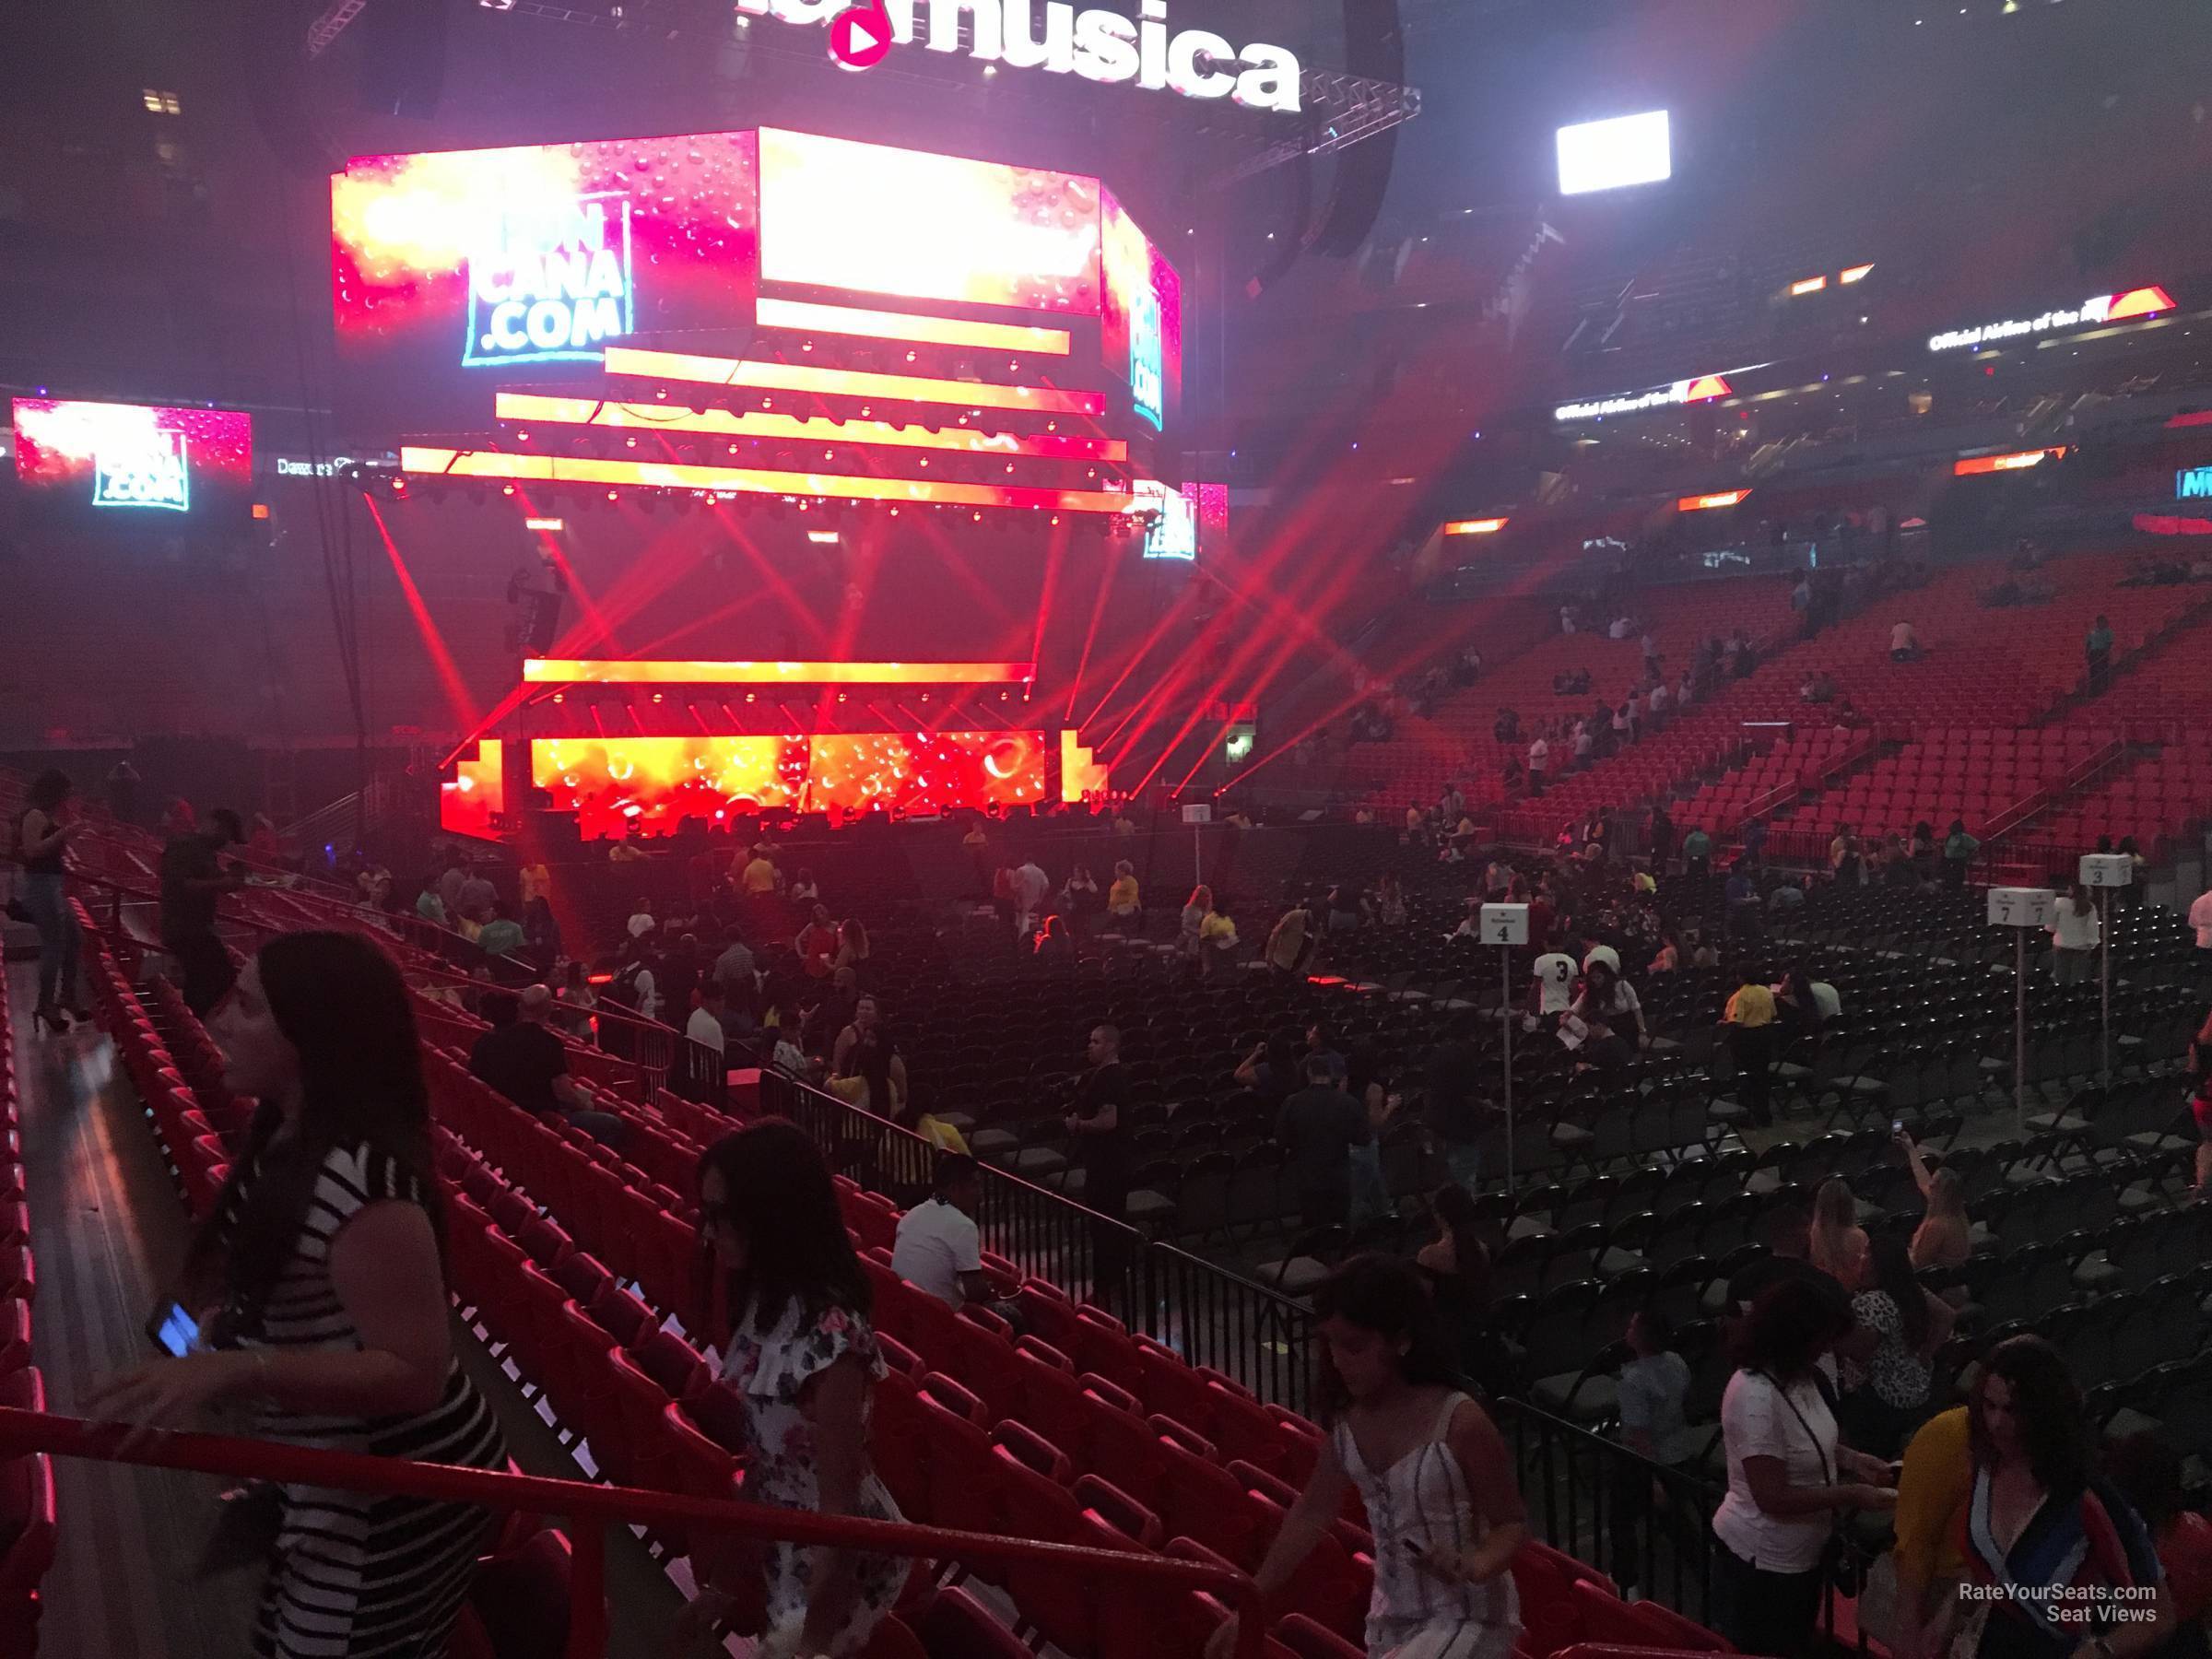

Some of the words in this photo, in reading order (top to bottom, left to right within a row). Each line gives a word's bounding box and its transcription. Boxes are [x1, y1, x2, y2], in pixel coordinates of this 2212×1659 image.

[480, 298, 621, 350] .COM
[1929, 328, 1982, 350] Official
[2032, 312, 2051, 331] of
[2093, 871, 2102, 884] 3
[2001, 907, 2009, 922] 7
[1497, 925, 1509, 941] 4
[1556, 960, 1568, 982] 3
